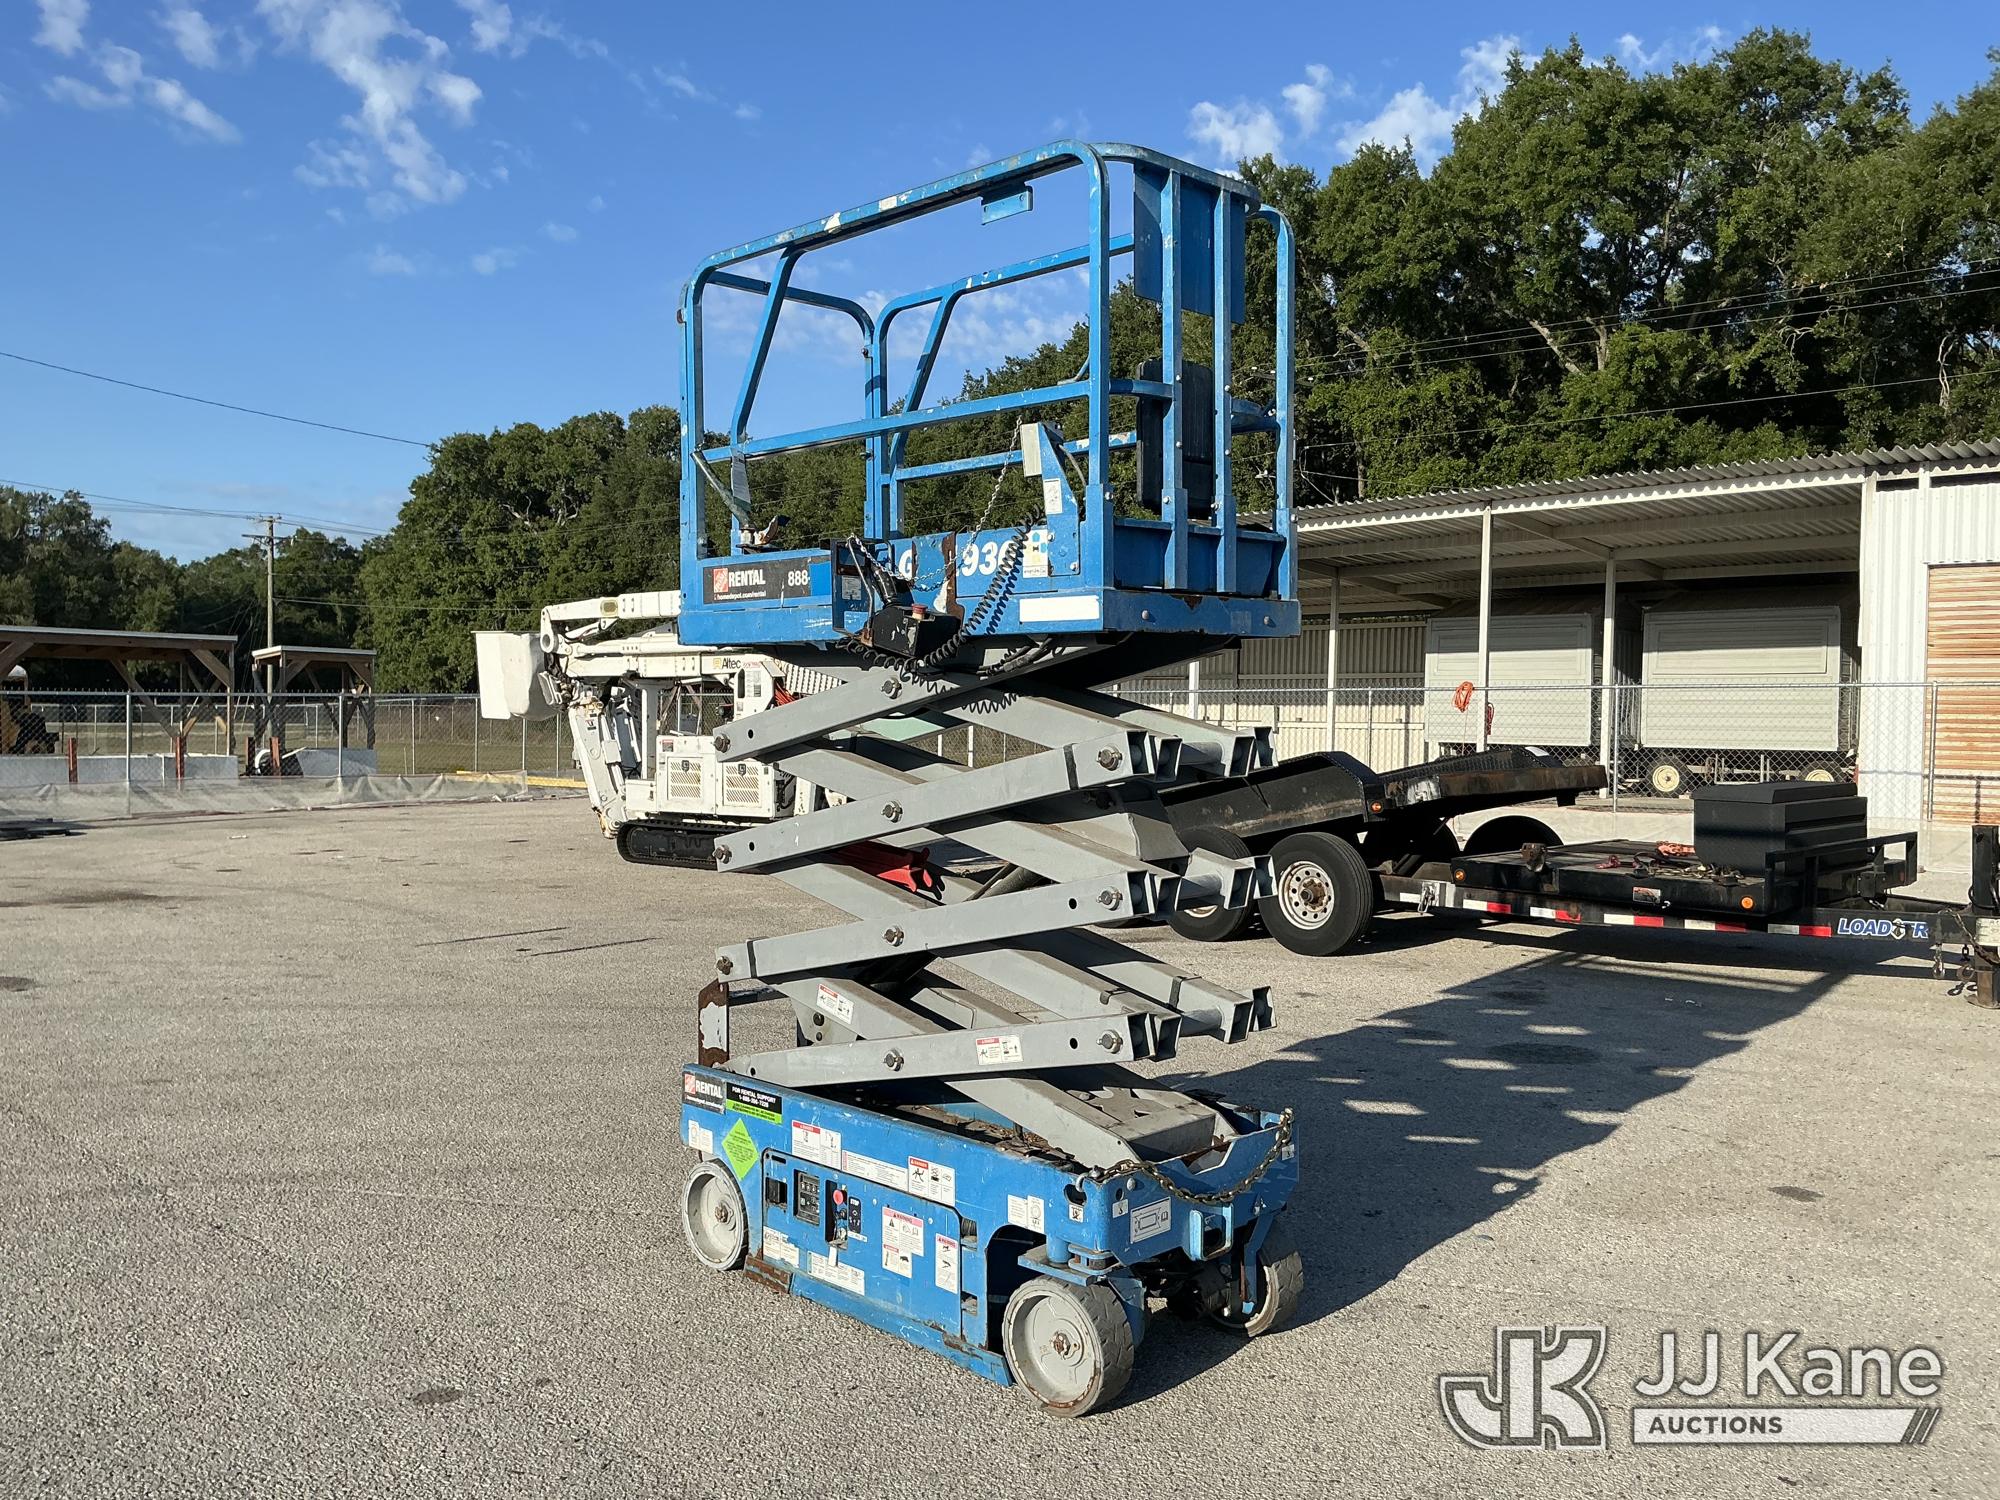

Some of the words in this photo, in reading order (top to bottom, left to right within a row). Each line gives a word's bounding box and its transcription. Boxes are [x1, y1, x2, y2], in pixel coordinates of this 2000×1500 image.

[728, 569, 766, 588] RENTAL
[722, 657, 742, 669] Altec
[1838, 918, 1892, 936] LOAD
[695, 1080, 723, 1098] RENTAL
